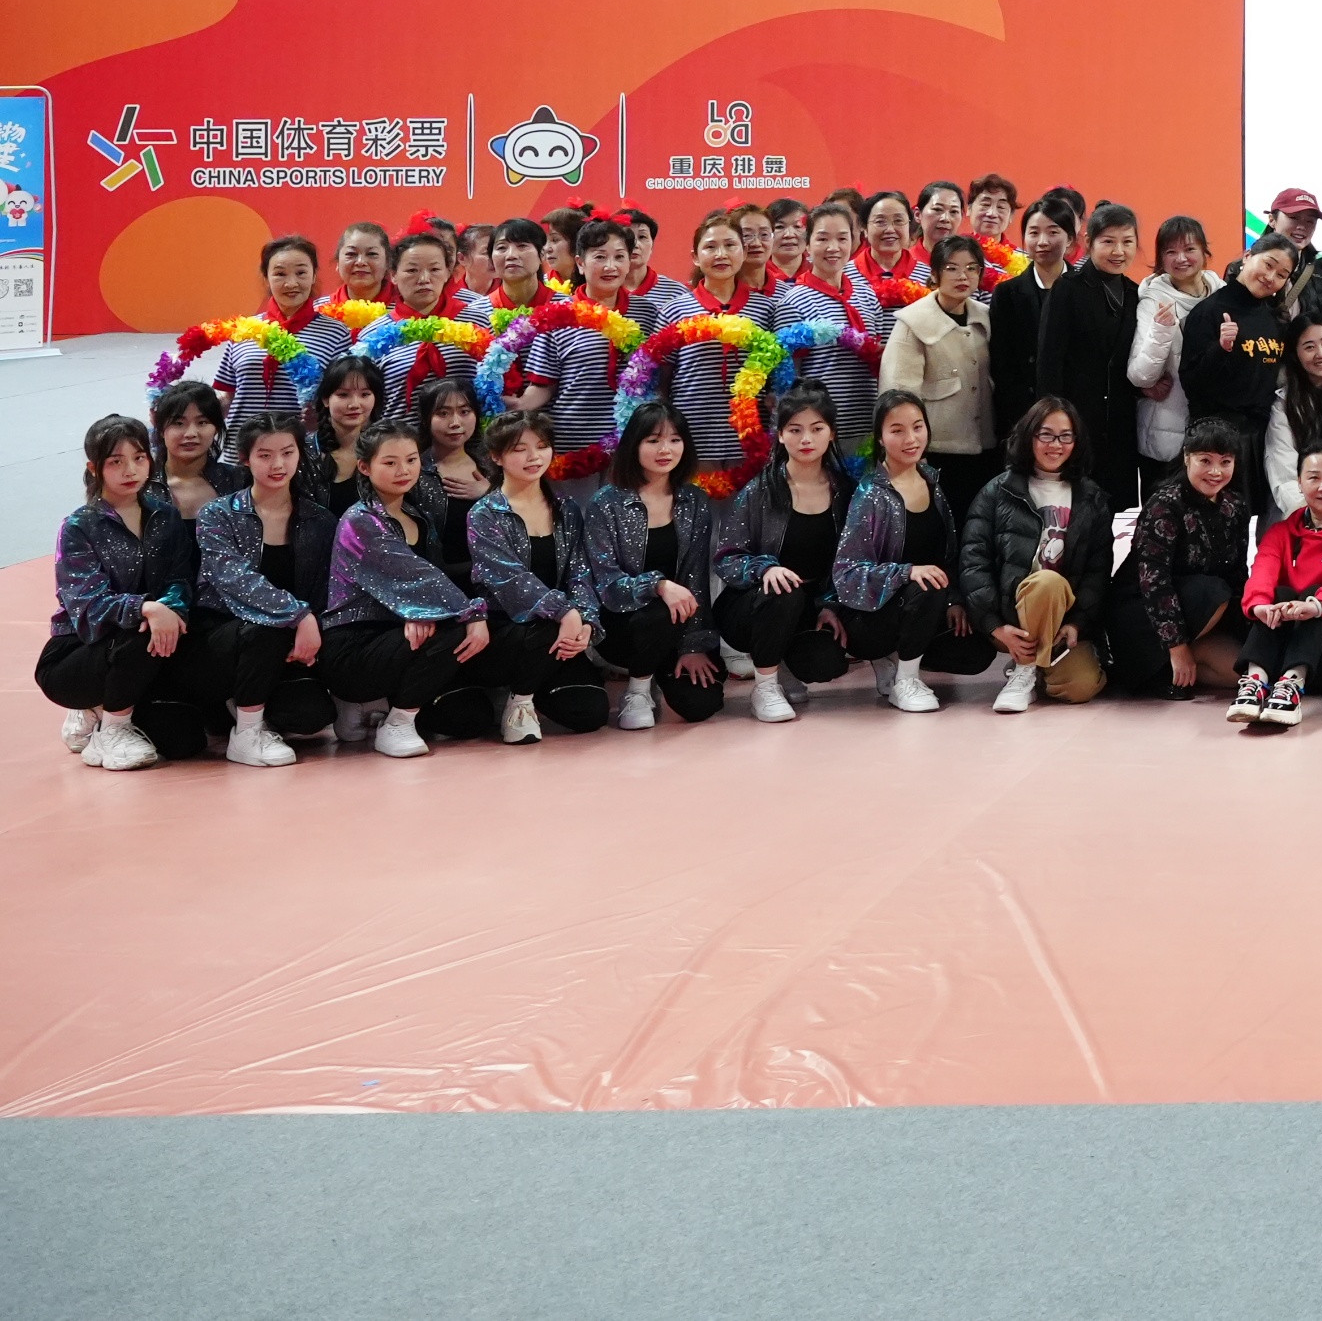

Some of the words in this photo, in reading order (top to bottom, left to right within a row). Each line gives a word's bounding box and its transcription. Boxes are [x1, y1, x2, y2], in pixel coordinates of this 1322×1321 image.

[191, 118, 447, 160] 中国体育彩票
[670, 156, 786, 176] 重庆排舞
[193, 167, 257, 187] CHINA
[261, 167, 345, 187] SPORTS
[350, 167, 446, 187] LOTTERY
[646, 178, 728, 190] CHONGQING
[733, 177, 810, 189] LINEDANCE
[1241, 336, 1285, 357] 中国排
